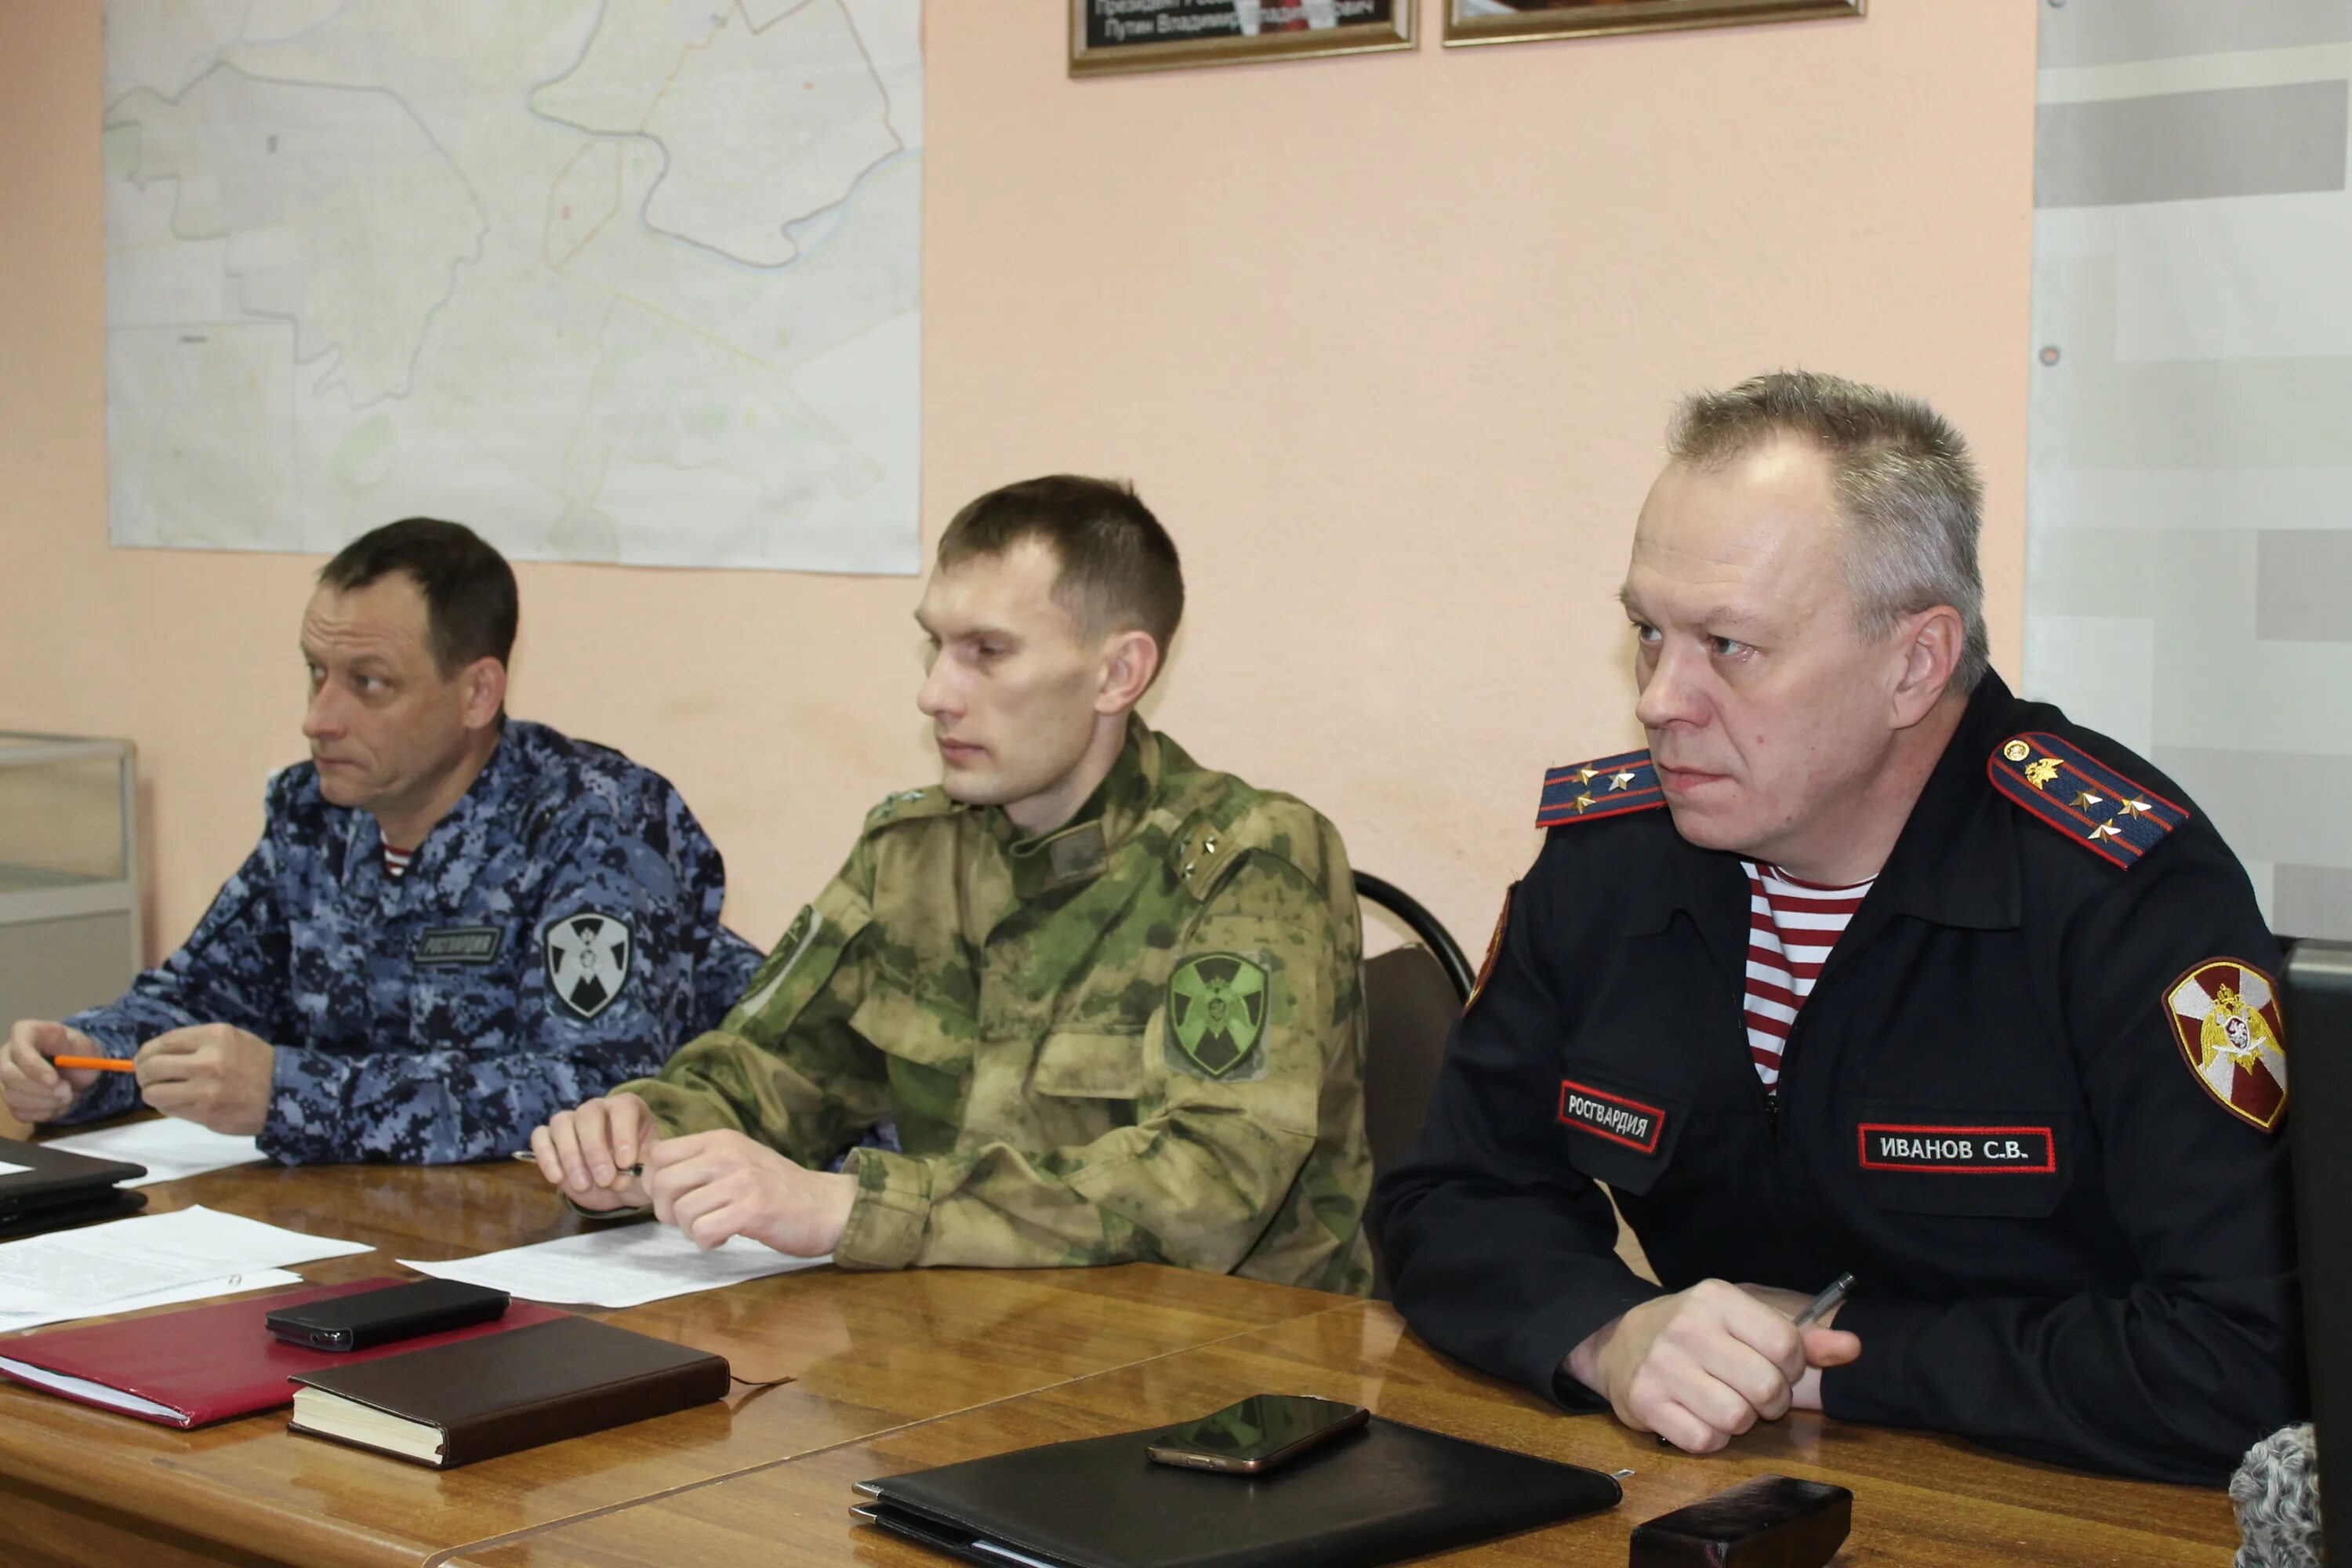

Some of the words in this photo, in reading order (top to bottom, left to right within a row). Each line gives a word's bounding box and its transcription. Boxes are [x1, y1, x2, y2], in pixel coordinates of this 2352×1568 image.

[1105, 17, 1155, 42] Путин
[1156, 12, 1240, 34] Владимир
[1568, 1094, 1649, 1138] РОСГВАРДИЯ
[1880, 1137, 1973, 1159] ИВАНОВ
[1984, 1141, 2029, 1159] С.В.
